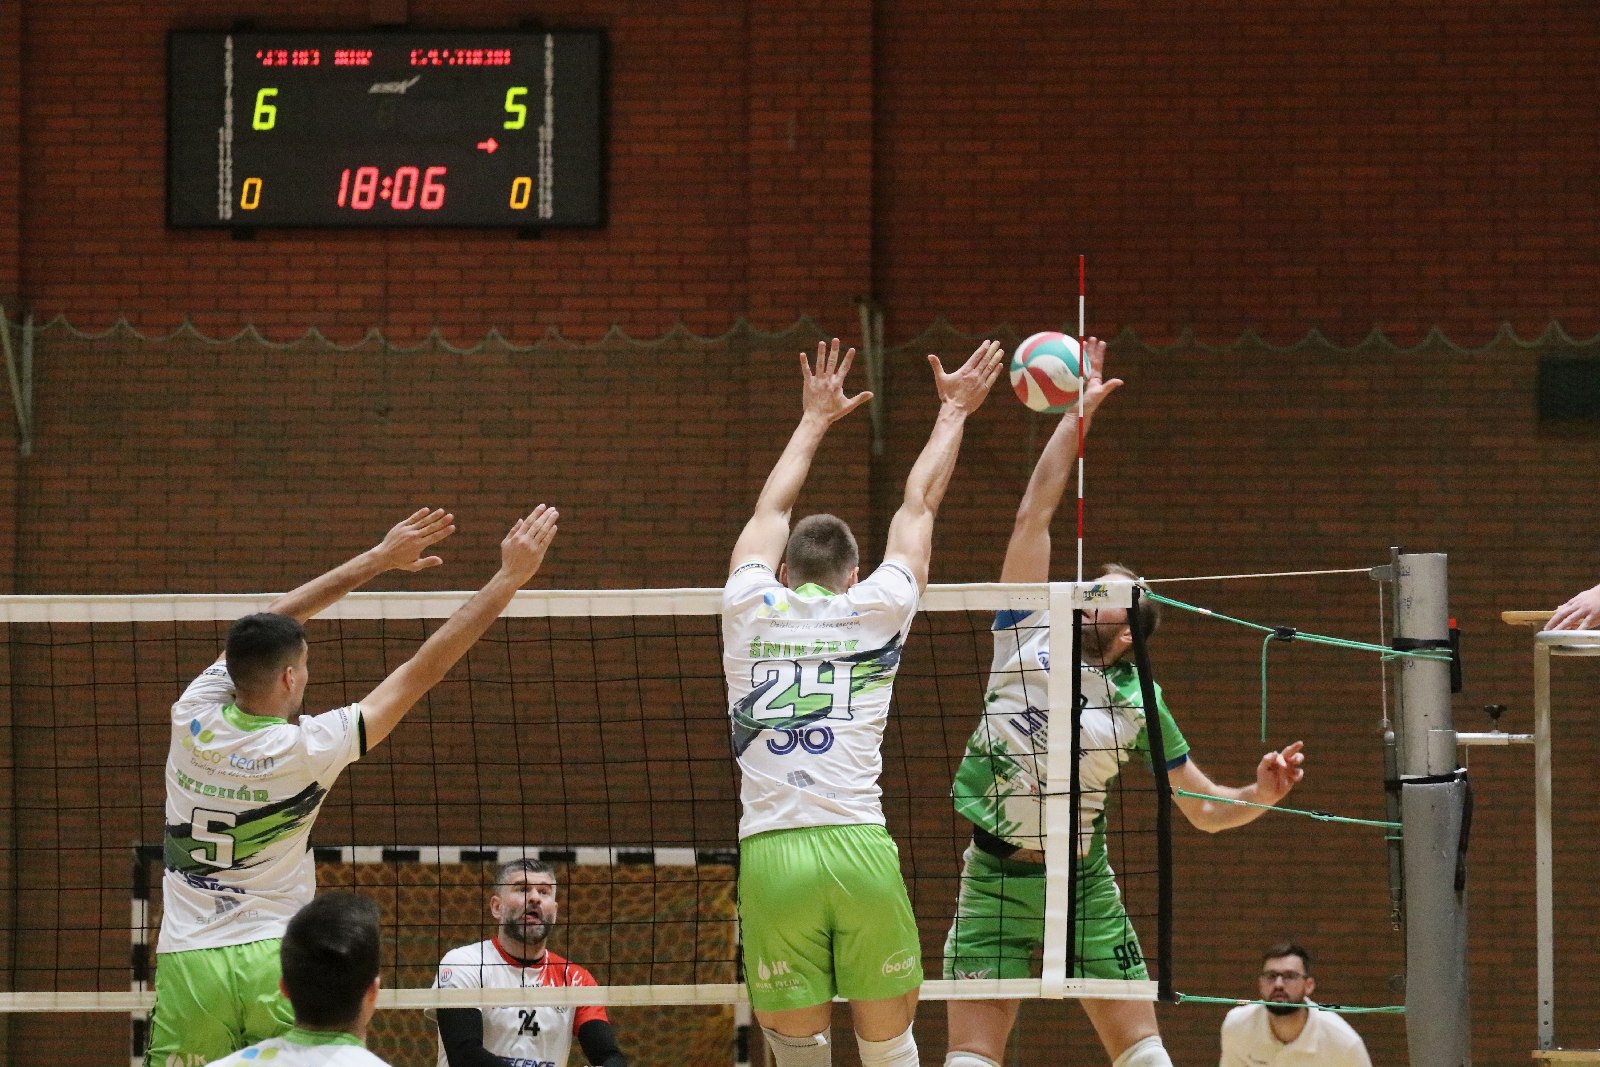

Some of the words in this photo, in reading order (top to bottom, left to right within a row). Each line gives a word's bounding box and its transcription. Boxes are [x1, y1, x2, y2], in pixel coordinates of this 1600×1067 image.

[252, 87, 278, 130] 6
[503, 86, 528, 129] 5
[240, 177, 262, 210] 0
[337, 166, 447, 210] 18:06
[509, 176, 532, 210] 0
[751, 659, 857, 721] 24
[190, 806, 237, 869] 5
[1113, 941, 1142, 971] 98
[518, 1009, 541, 1037] 24
